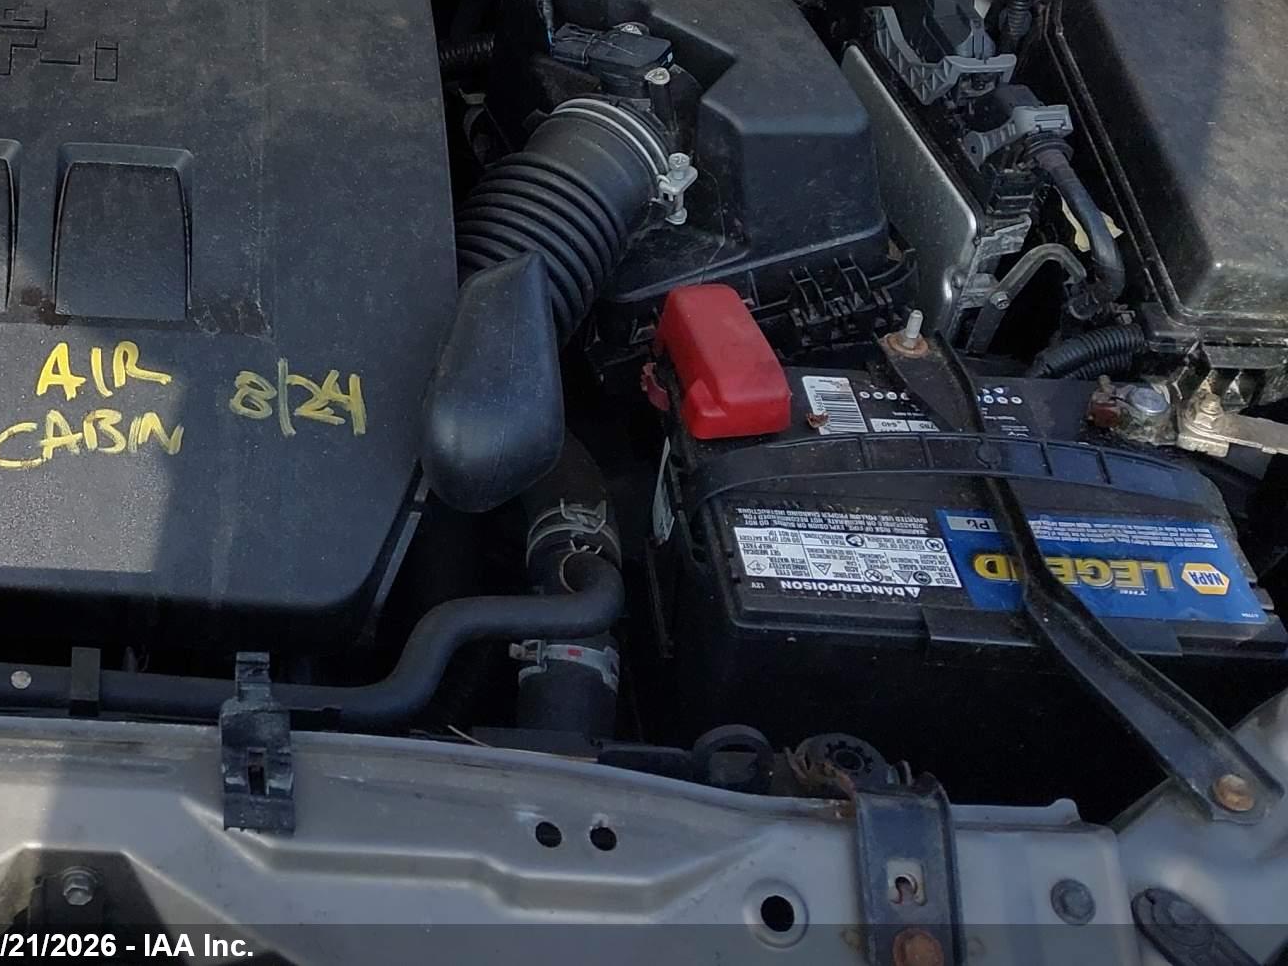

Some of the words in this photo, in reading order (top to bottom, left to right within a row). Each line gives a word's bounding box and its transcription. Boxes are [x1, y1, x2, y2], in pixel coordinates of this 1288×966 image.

[35, 341, 172, 401] AIR
[229, 356, 366, 437] 8/24
[1187, 570, 1225, 587] NAPA
